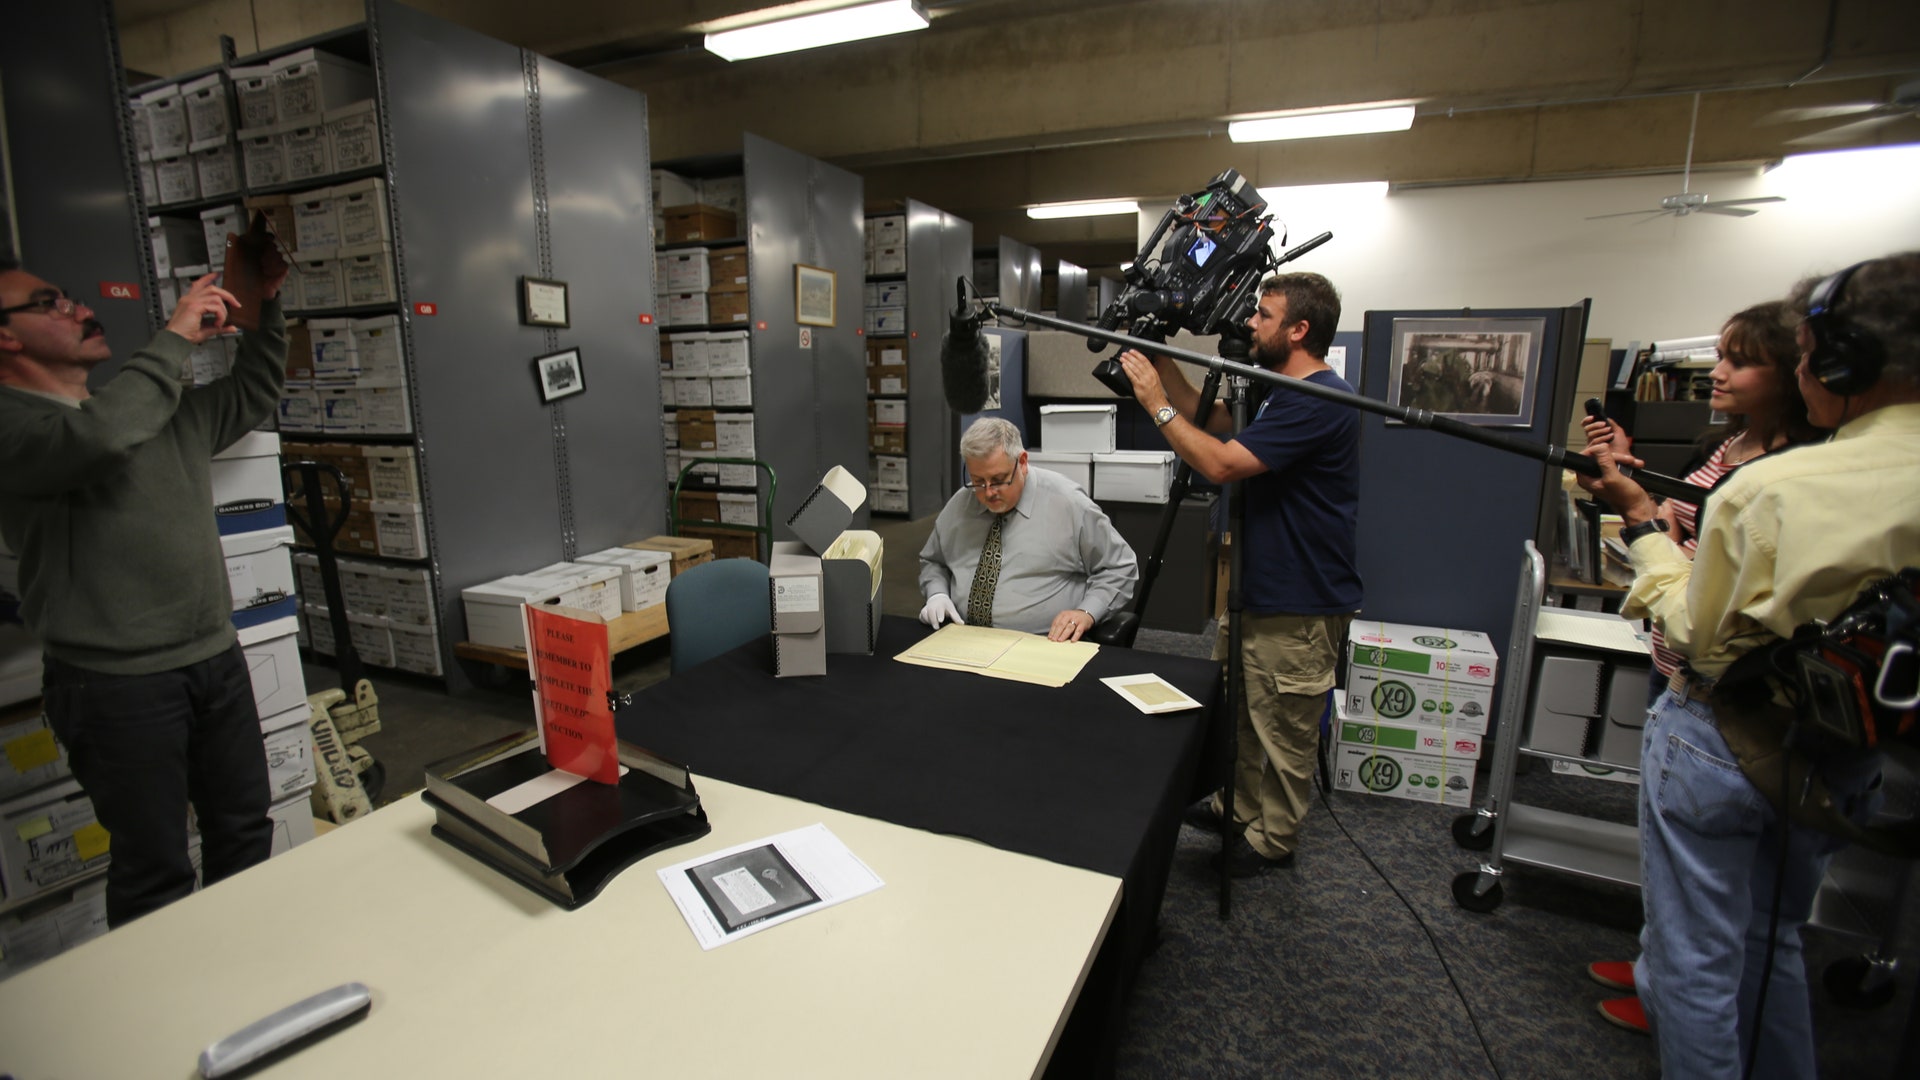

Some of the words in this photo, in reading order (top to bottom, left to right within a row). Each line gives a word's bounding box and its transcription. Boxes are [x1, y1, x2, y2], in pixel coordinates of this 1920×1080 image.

[110, 286, 131, 298] GA
[218, 504, 254, 513] BANKERS
[547, 628, 574, 643] PLEASE
[579, 662, 592, 672] TO
[1436, 661, 1445, 671] 10
[540, 673, 575, 692] MPLETE
[549, 721, 583, 741] SECTION
[1424, 737, 1433, 747] 10
